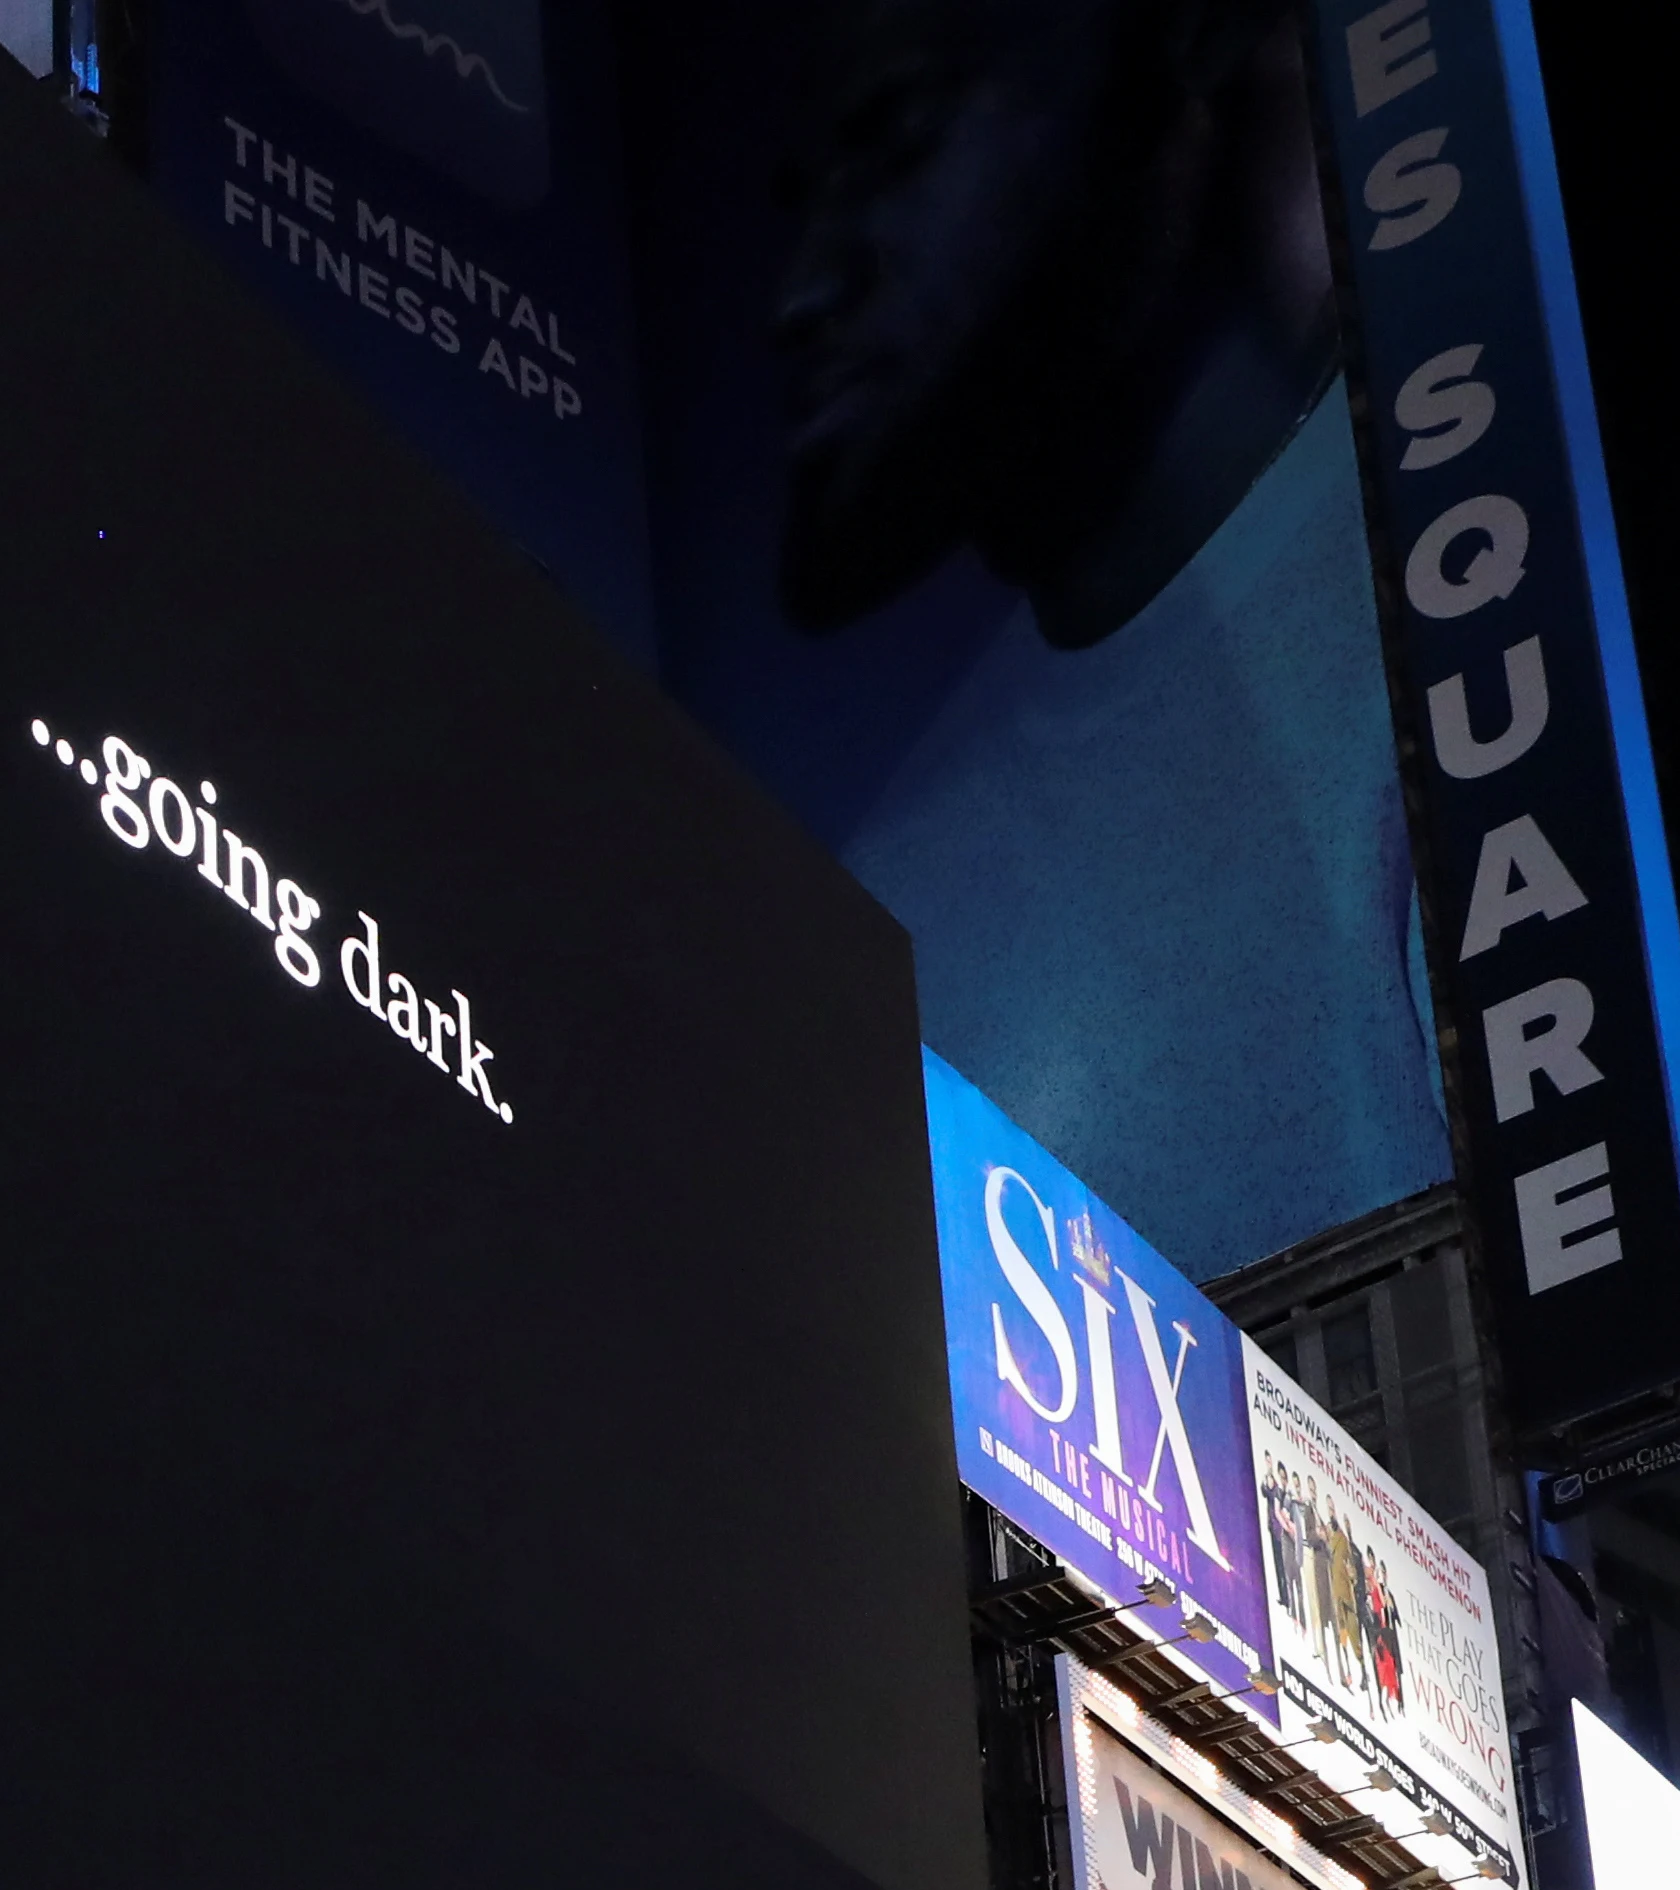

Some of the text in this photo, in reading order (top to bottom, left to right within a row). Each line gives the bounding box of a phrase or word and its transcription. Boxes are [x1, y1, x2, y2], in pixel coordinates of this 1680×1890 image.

[224, 115, 576, 366] THE MENTAL
[225, 179, 583, 420] FITNESS APP
[31, 718, 514, 1124] ...going dark.
[1394, 343, 1623, 1298] SQUARE
[984, 1166, 1232, 1572] SIX
[1256, 1369, 1472, 1590] BROADWAY'S FUNNIEST SMASH HIT
[1049, 1428, 1194, 1584] THE MUSICAL
[1253, 1392, 1483, 1623] AND INTERNATIONAL PHENOMENON
[1334, 1711, 1375, 1760] WORLD
[1404, 1621, 1501, 1735] THAT GOES
[1405, 1588, 1484, 1682] THE PLAY
[1407, 1659, 1506, 1794] WRONG
